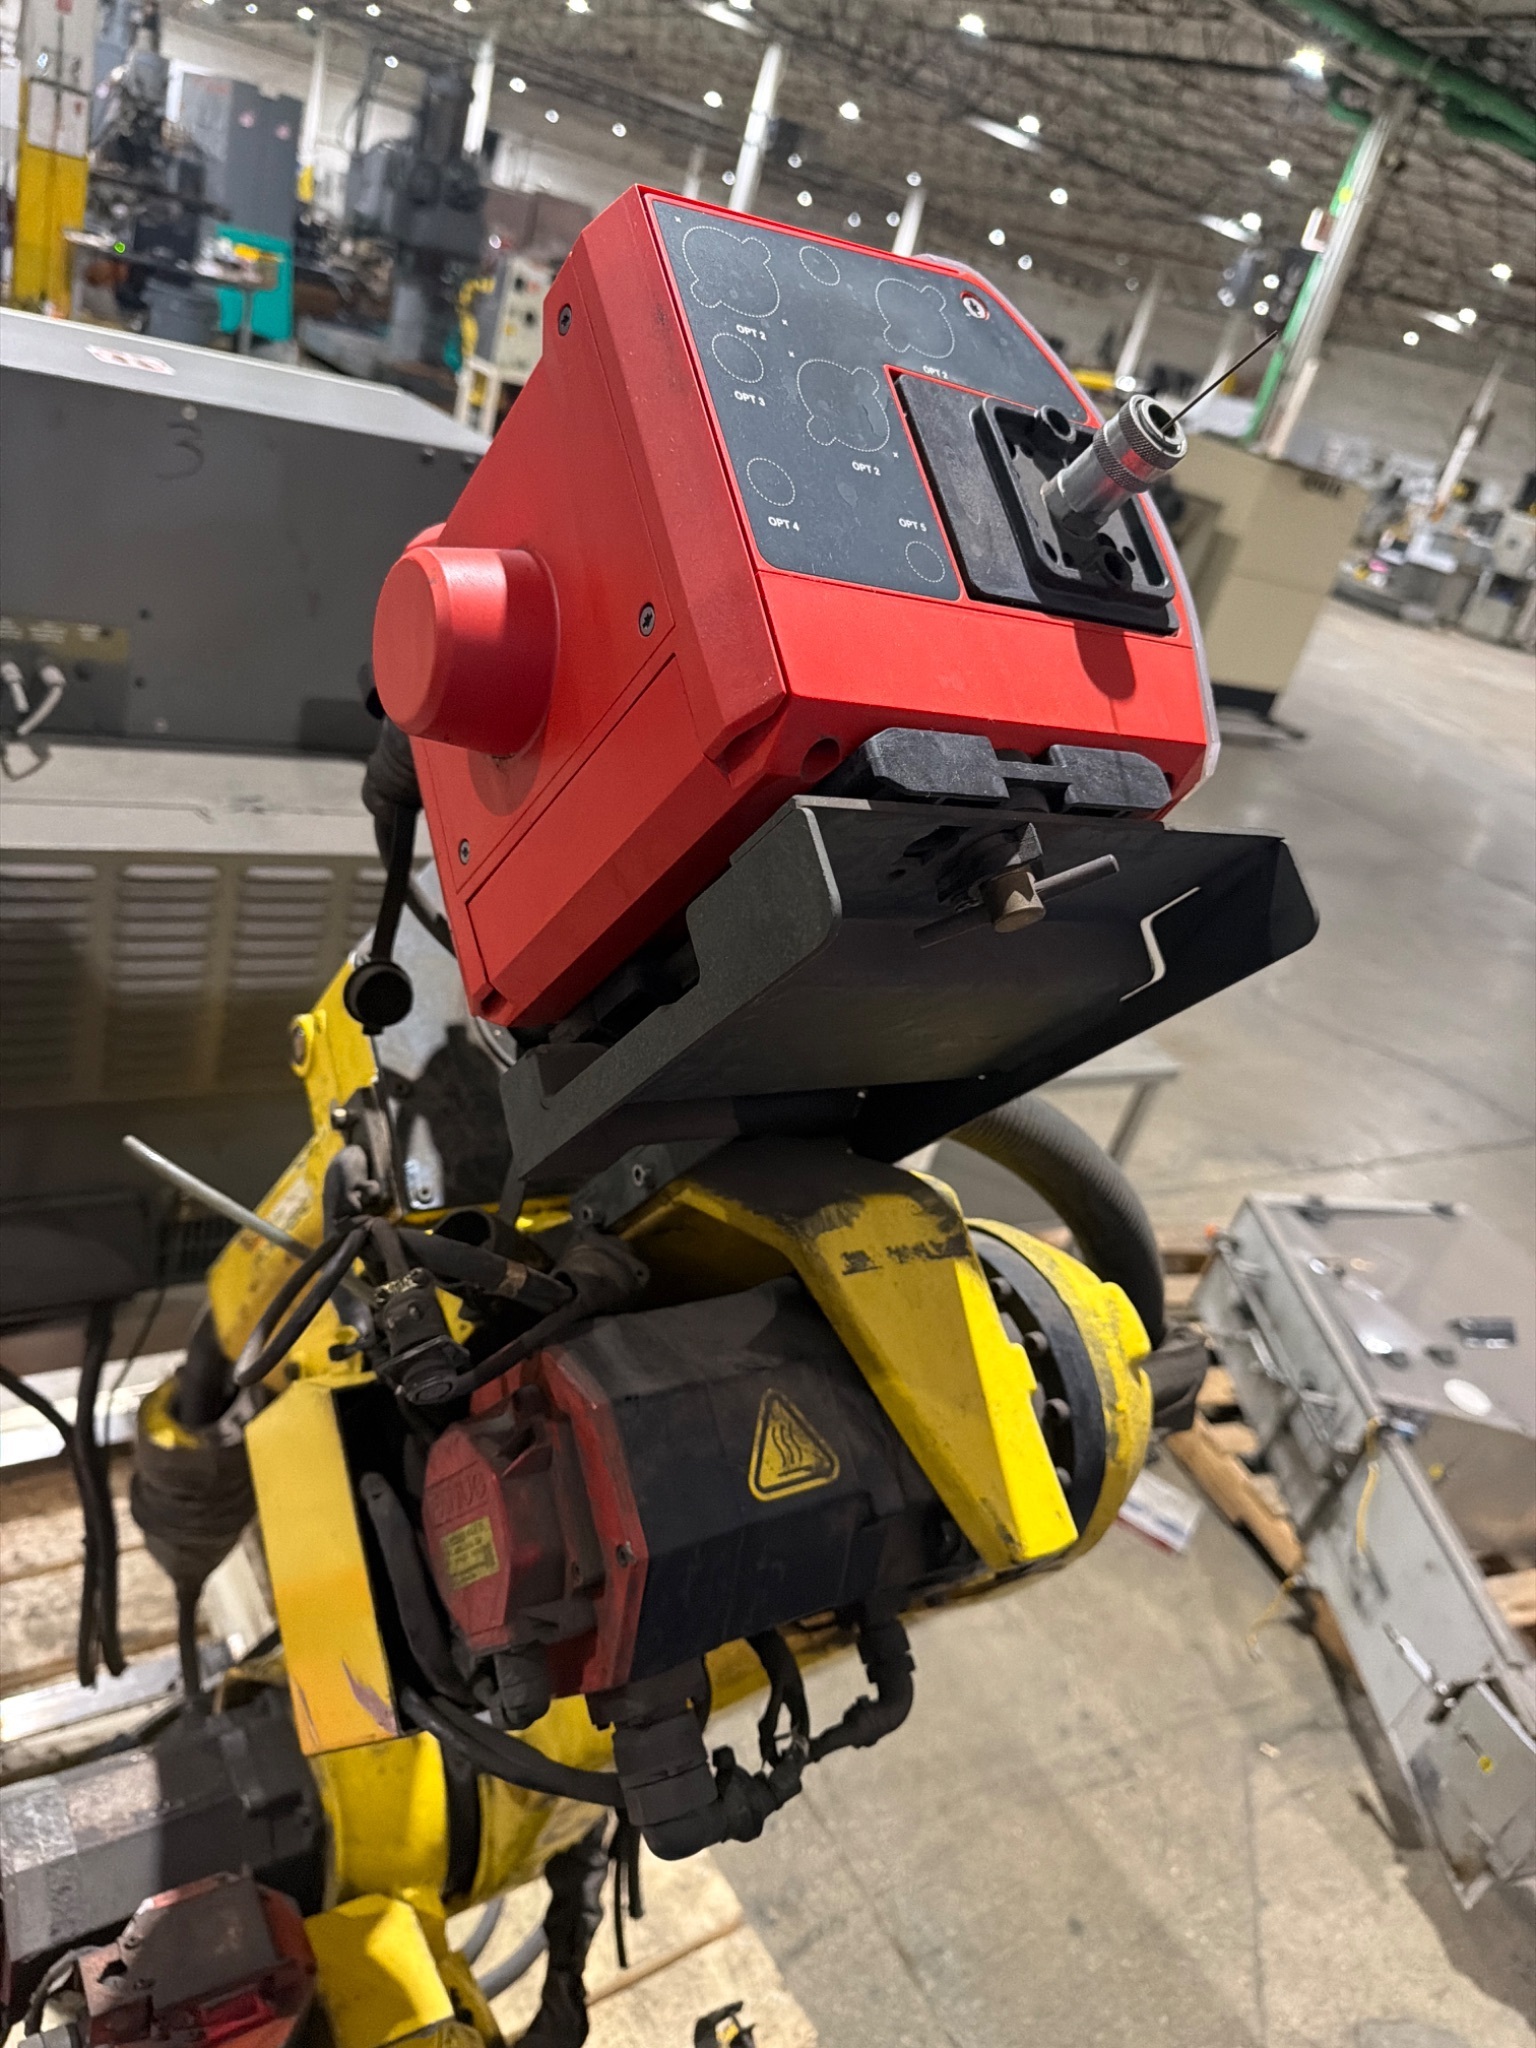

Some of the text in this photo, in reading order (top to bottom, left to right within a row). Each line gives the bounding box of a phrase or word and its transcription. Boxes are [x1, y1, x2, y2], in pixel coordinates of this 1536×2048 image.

[736, 324, 767, 341] OPT 2
[923, 364, 949, 380] OPT 2
[734, 390, 766, 407] OPT 3
[851, 461, 881, 476] OPT 2
[768, 516, 800, 532] OPT 4
[898, 517, 927, 532] OPT 5
